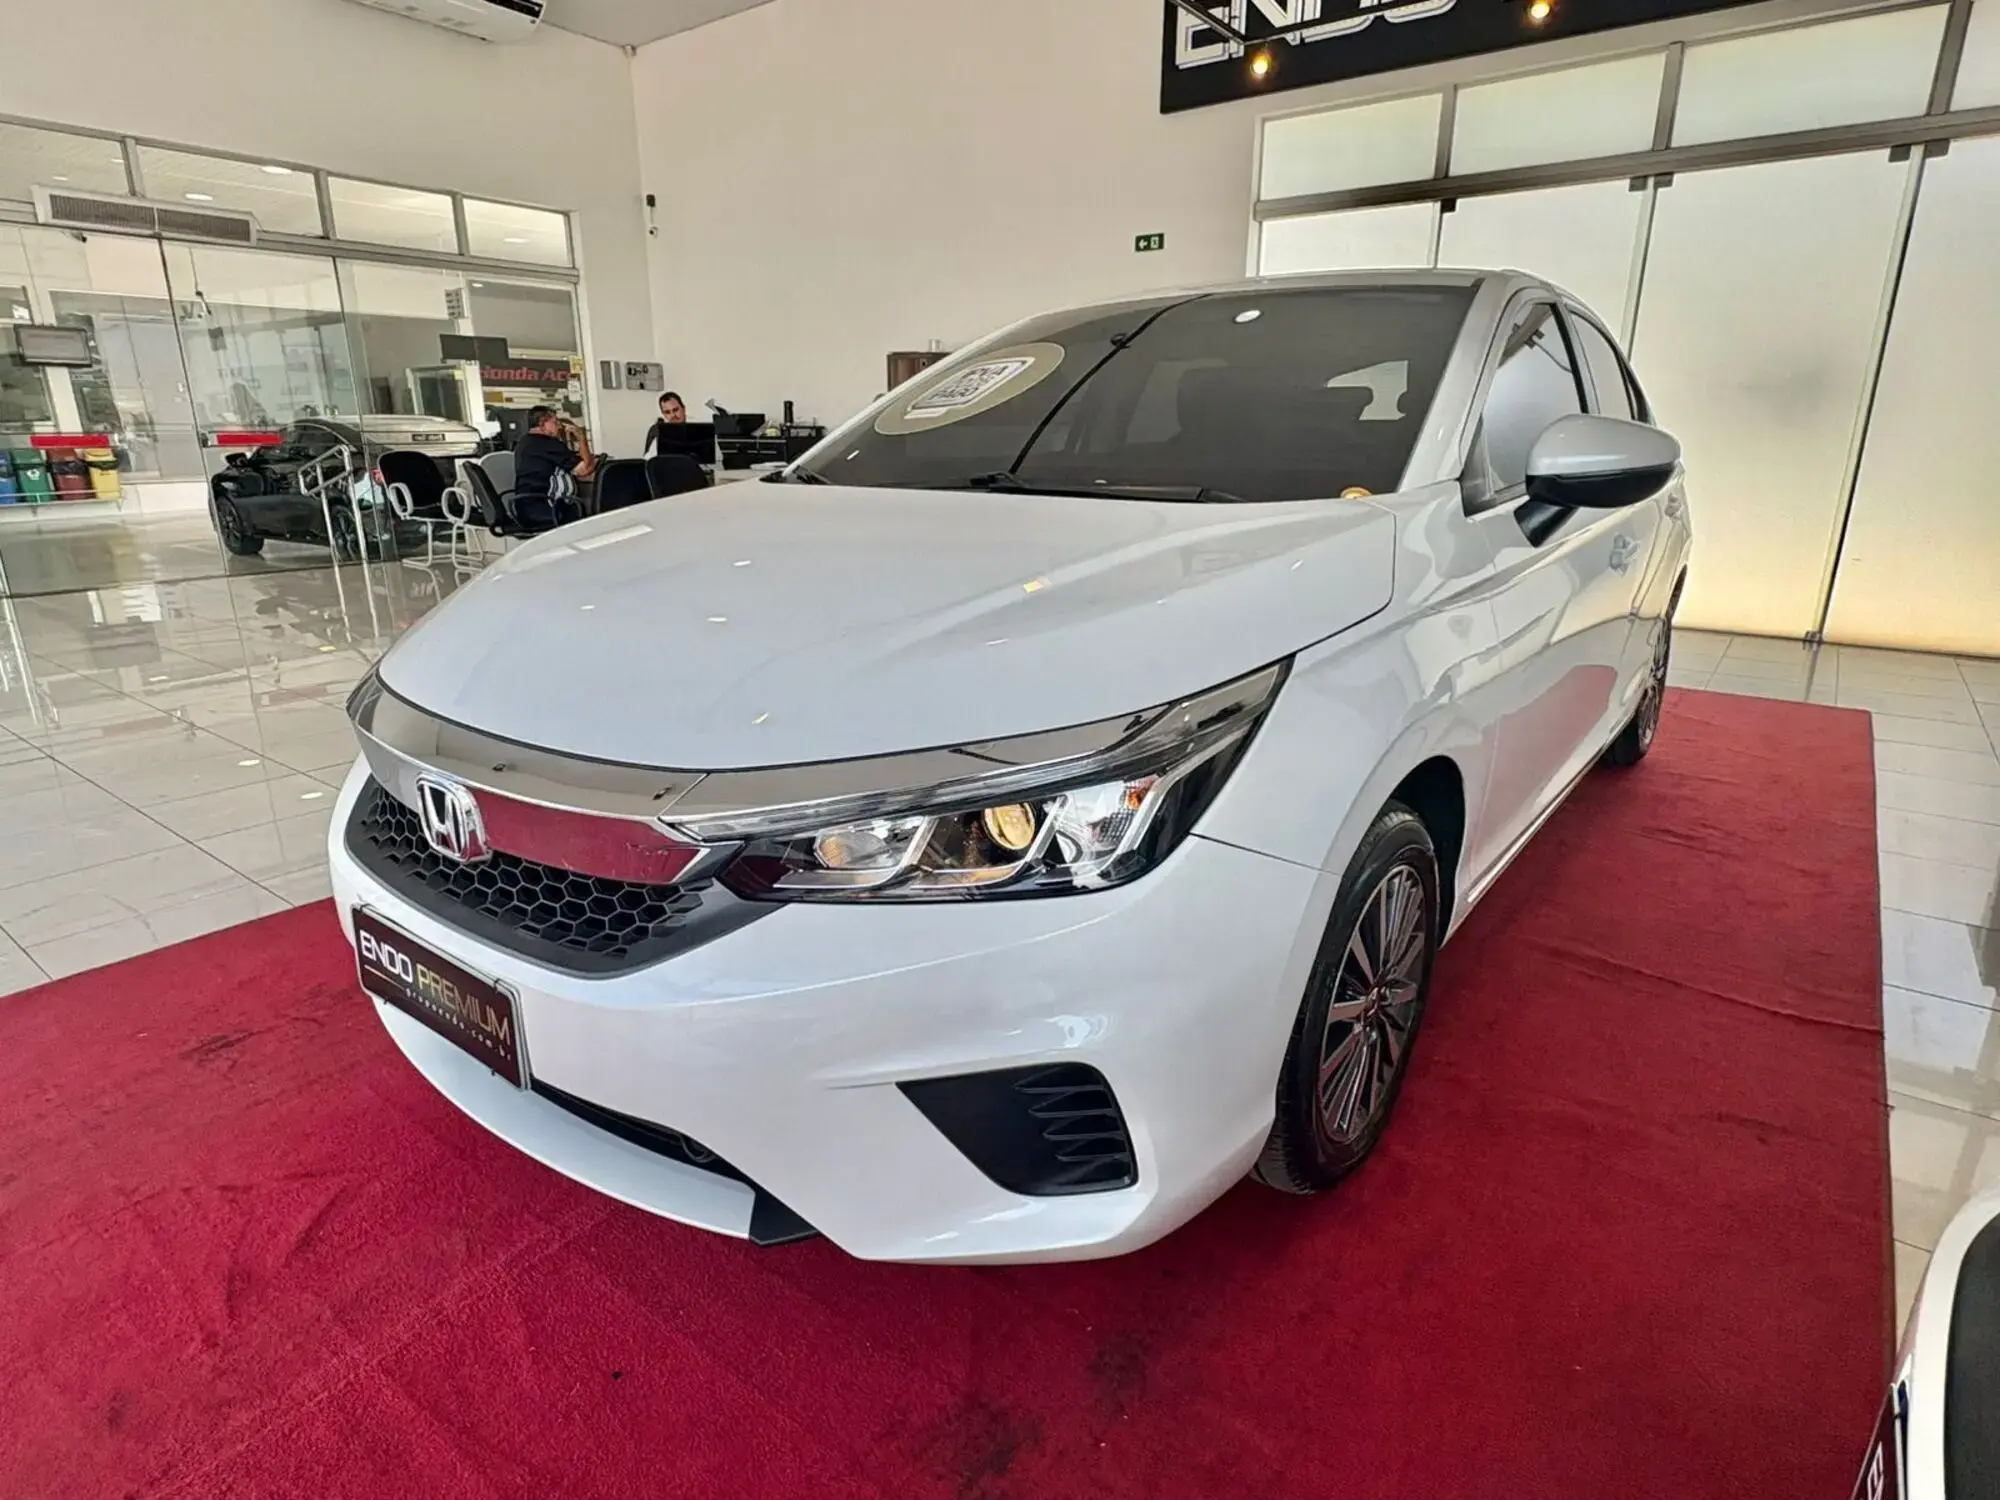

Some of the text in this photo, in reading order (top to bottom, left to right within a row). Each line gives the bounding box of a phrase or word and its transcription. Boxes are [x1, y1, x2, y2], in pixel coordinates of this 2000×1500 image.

[1175, 0, 1457, 70] EN
[542, 367, 571, 381] Ac
[360, 930, 413, 984] ENDO
[416, 963, 511, 1046] PREMIUM
